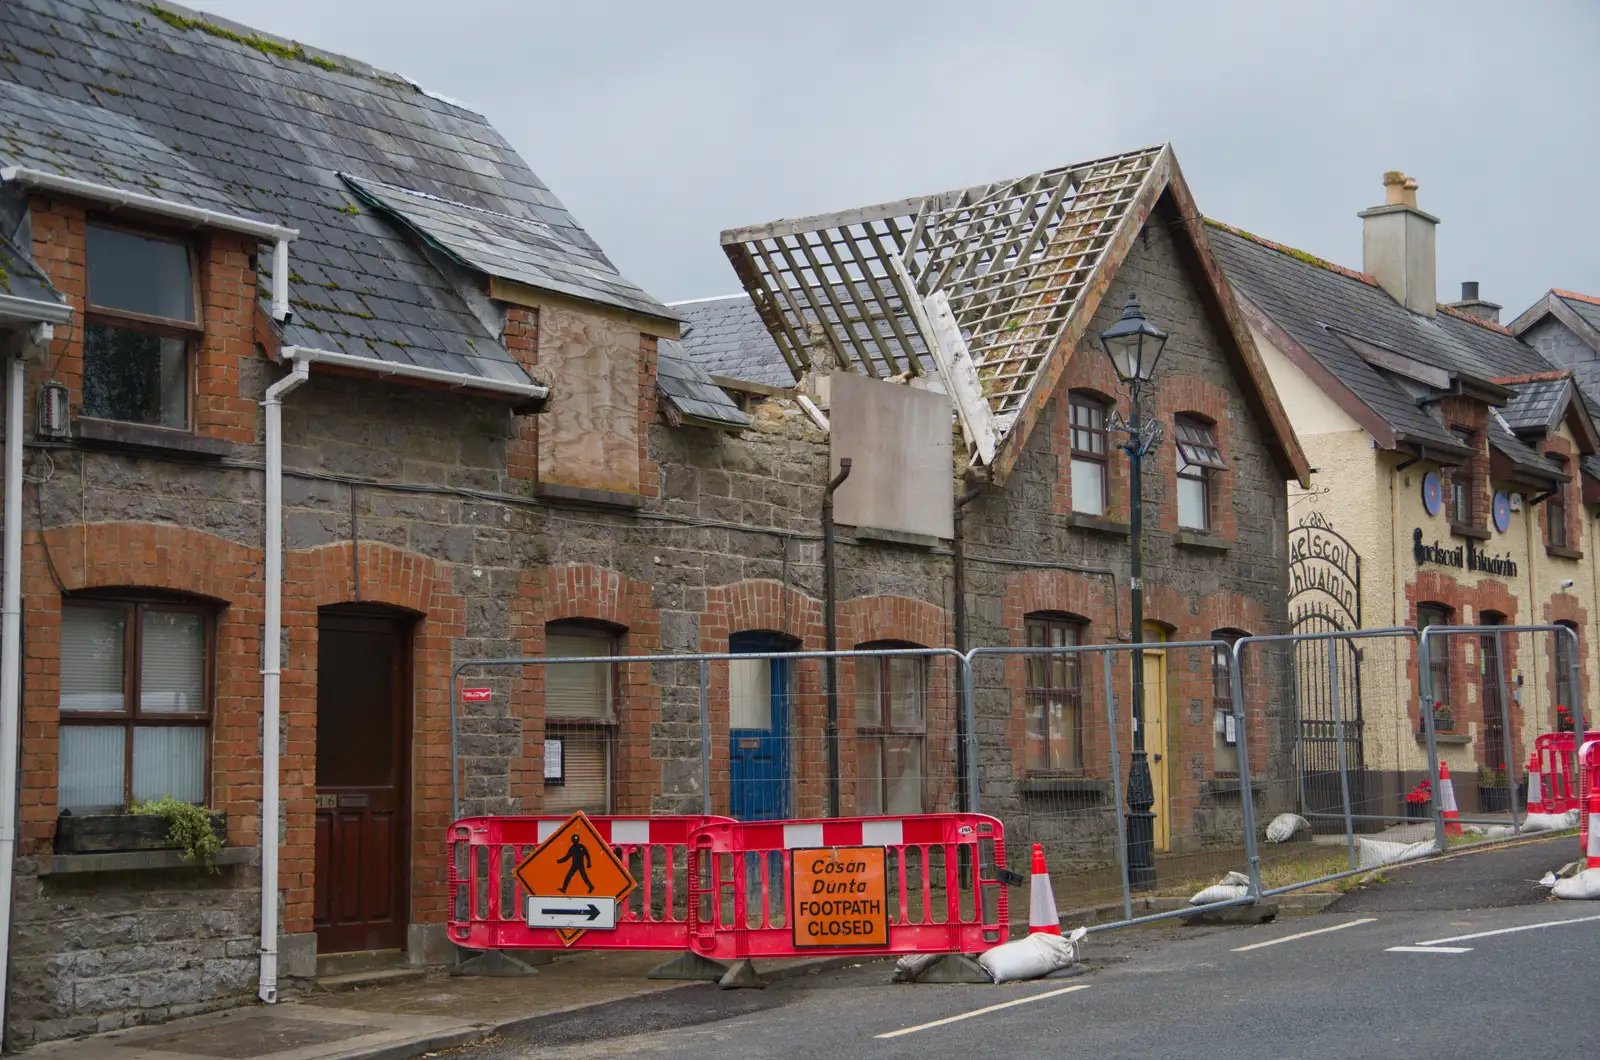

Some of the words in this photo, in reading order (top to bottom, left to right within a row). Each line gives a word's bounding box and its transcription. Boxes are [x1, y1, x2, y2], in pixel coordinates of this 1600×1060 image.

[811, 859, 867, 875] Cosán
[811, 879, 867, 894] Dúnta
[800, 899, 881, 917] FOOTPATH
[807, 920, 874, 936] CLOSED
